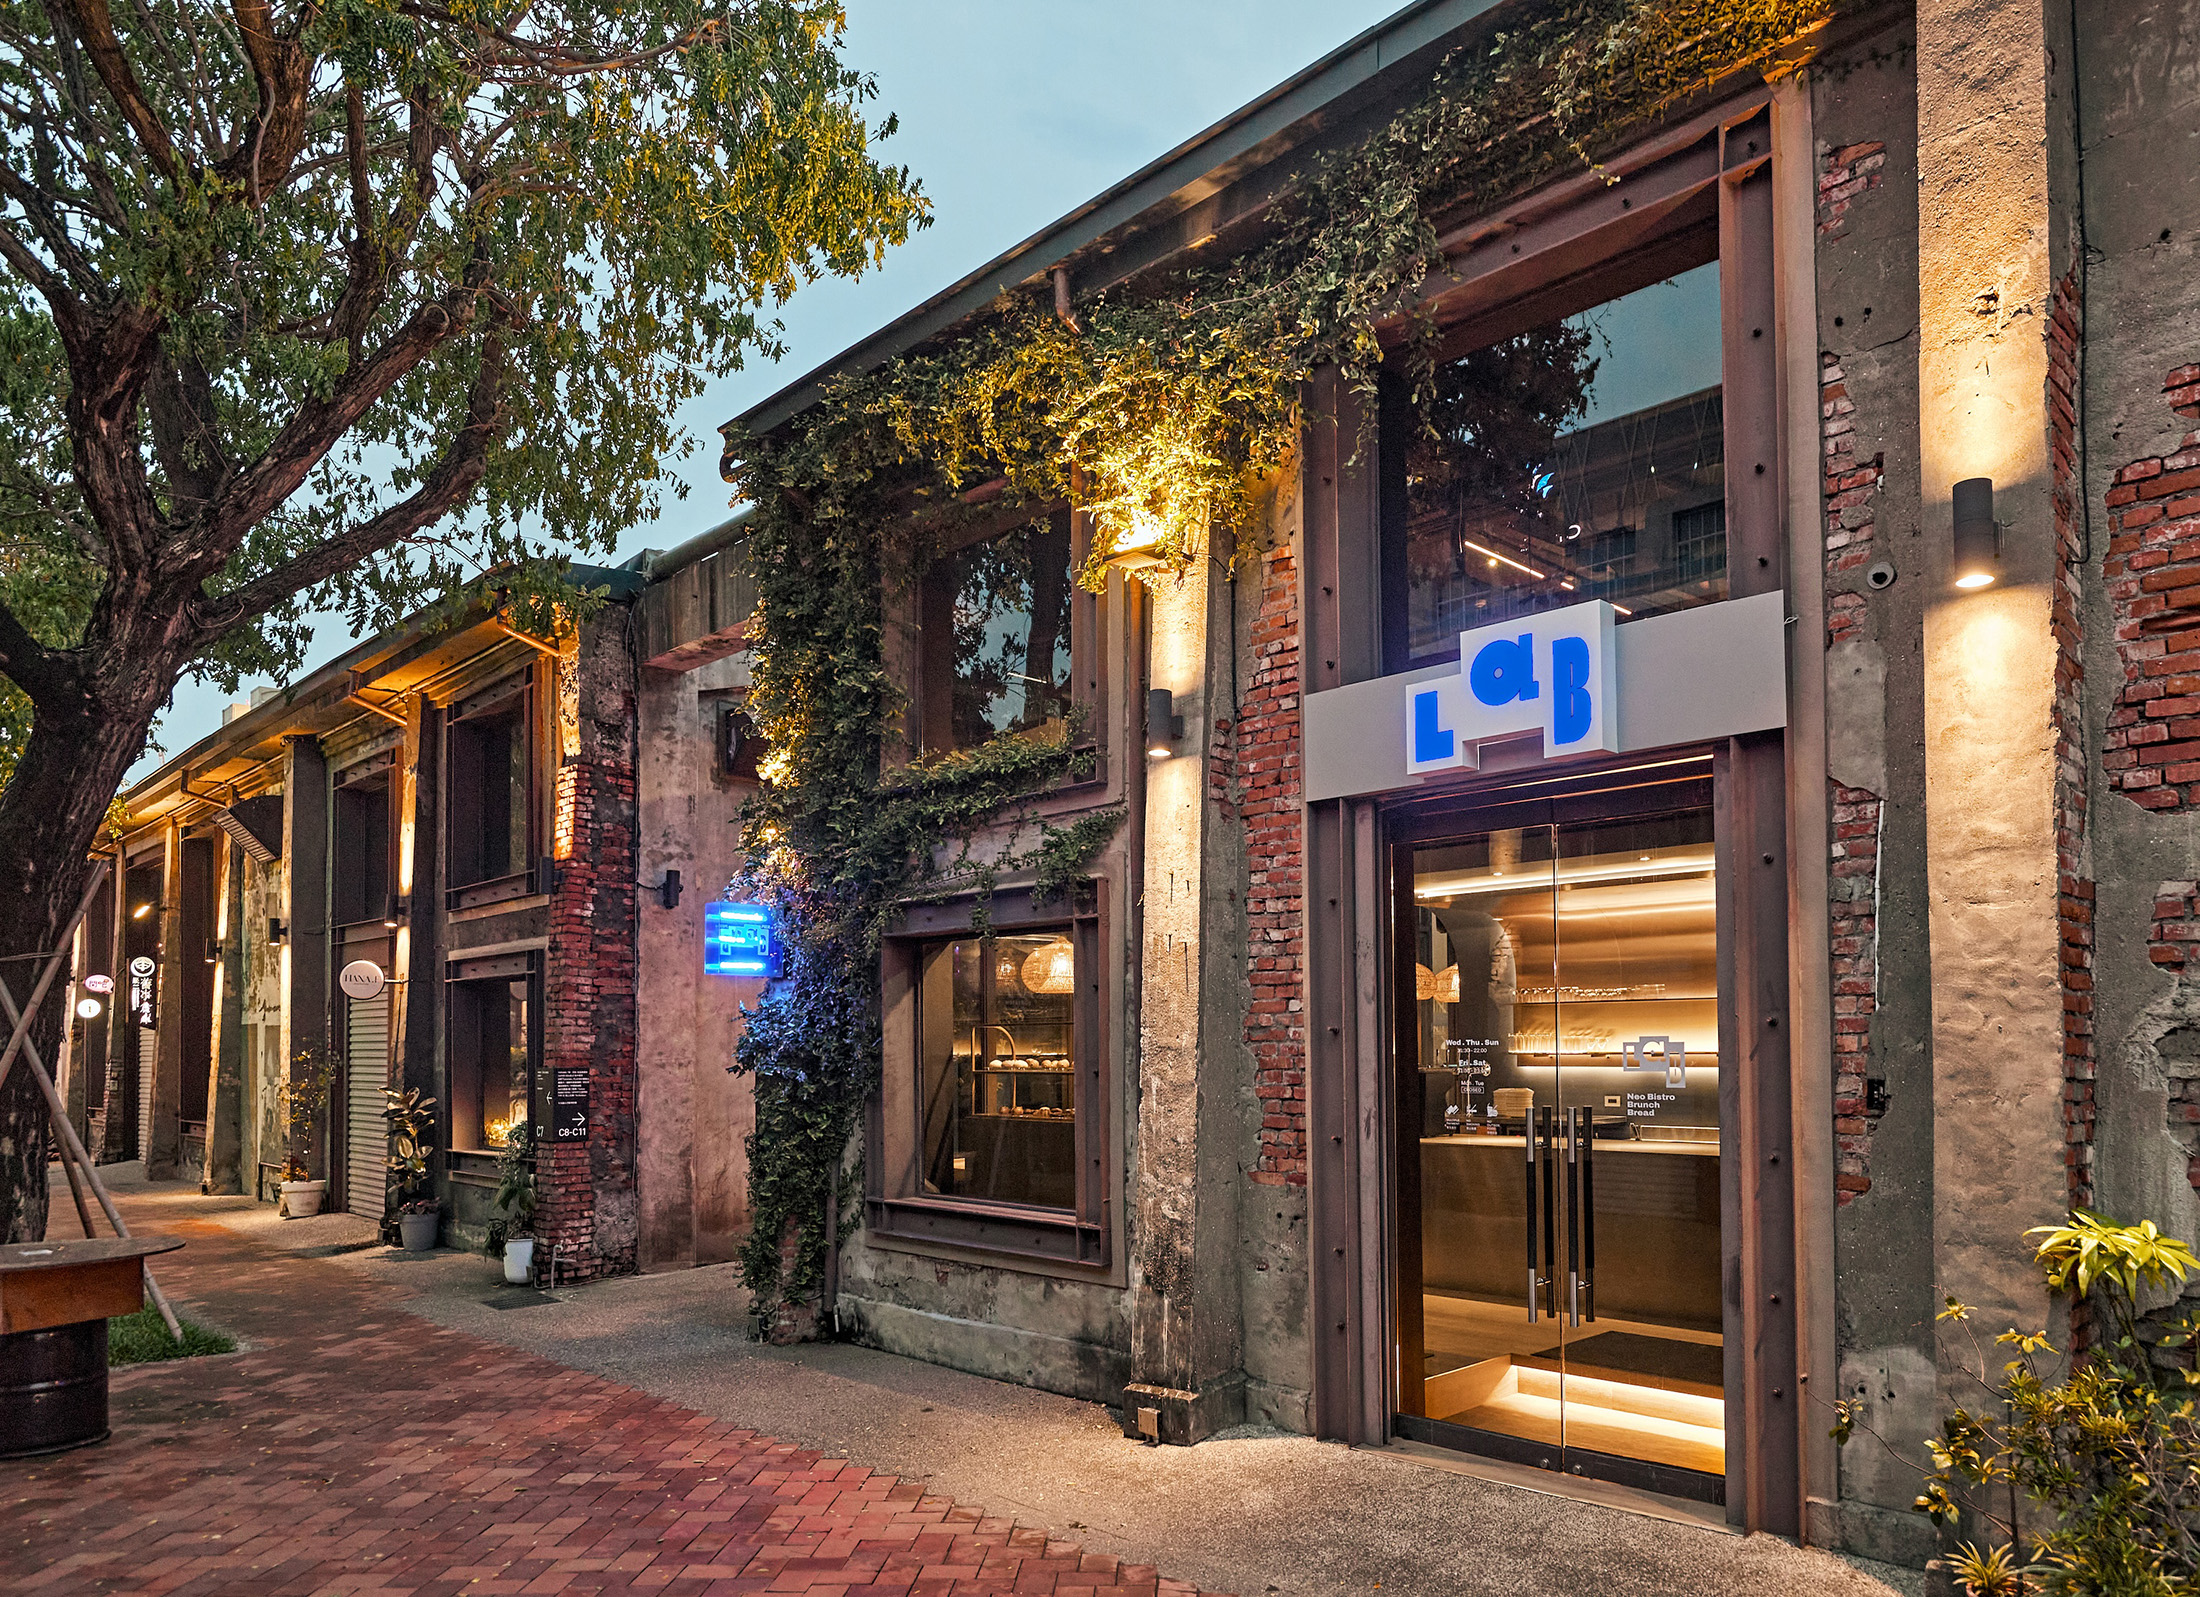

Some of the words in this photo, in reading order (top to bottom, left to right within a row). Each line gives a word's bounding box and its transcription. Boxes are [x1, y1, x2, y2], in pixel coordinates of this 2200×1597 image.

[1647, 1093, 1676, 1101] Bistro
[536, 1125, 544, 1137] C7
[558, 1127, 586, 1137] C8-C11
